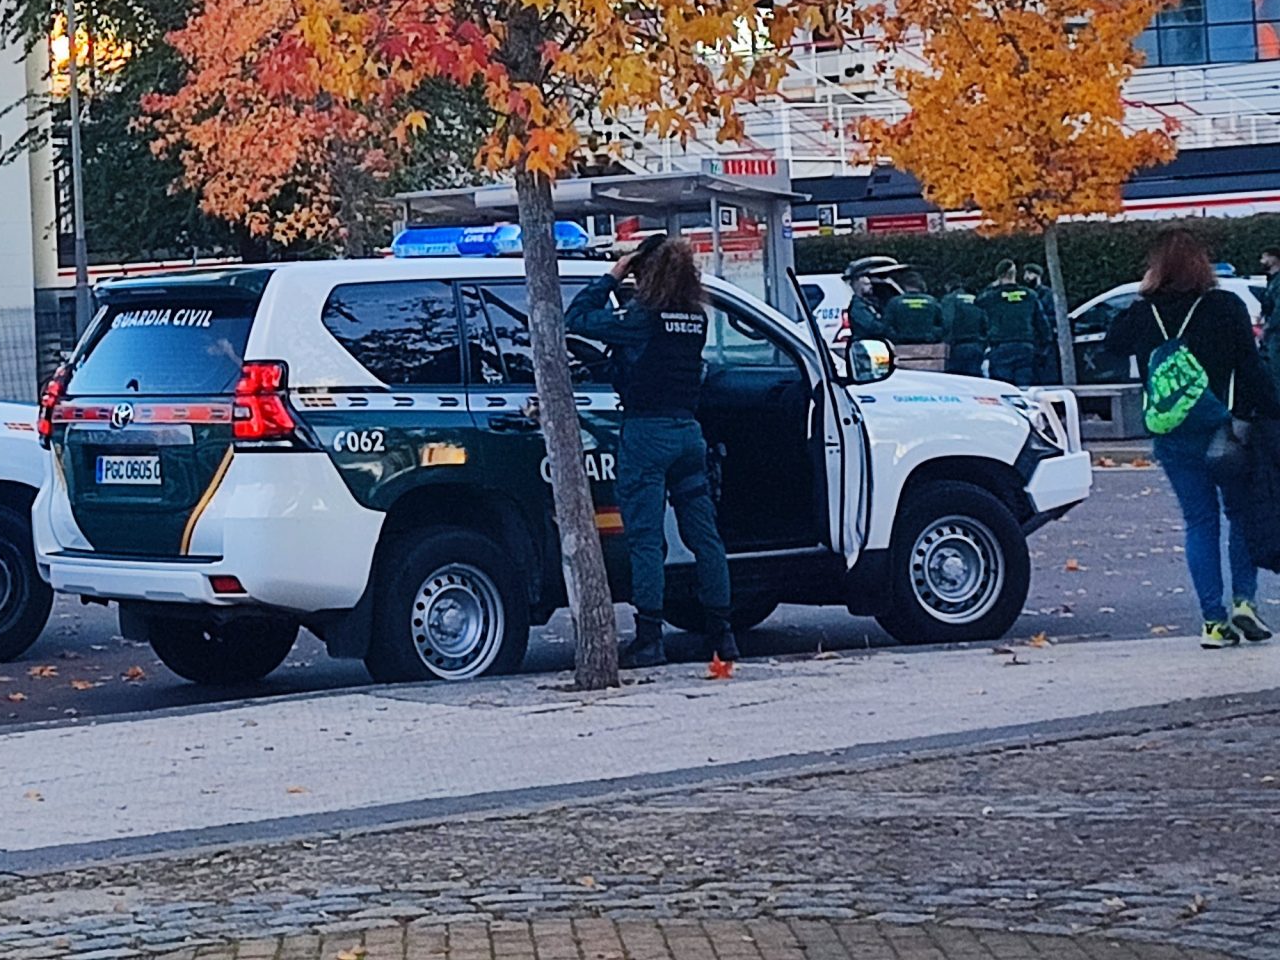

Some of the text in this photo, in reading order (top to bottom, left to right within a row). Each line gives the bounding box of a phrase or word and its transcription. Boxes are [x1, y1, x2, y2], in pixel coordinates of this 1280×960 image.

[111, 309, 213, 329] GUARDIA CIVIL
[346, 430, 385, 452] 062
